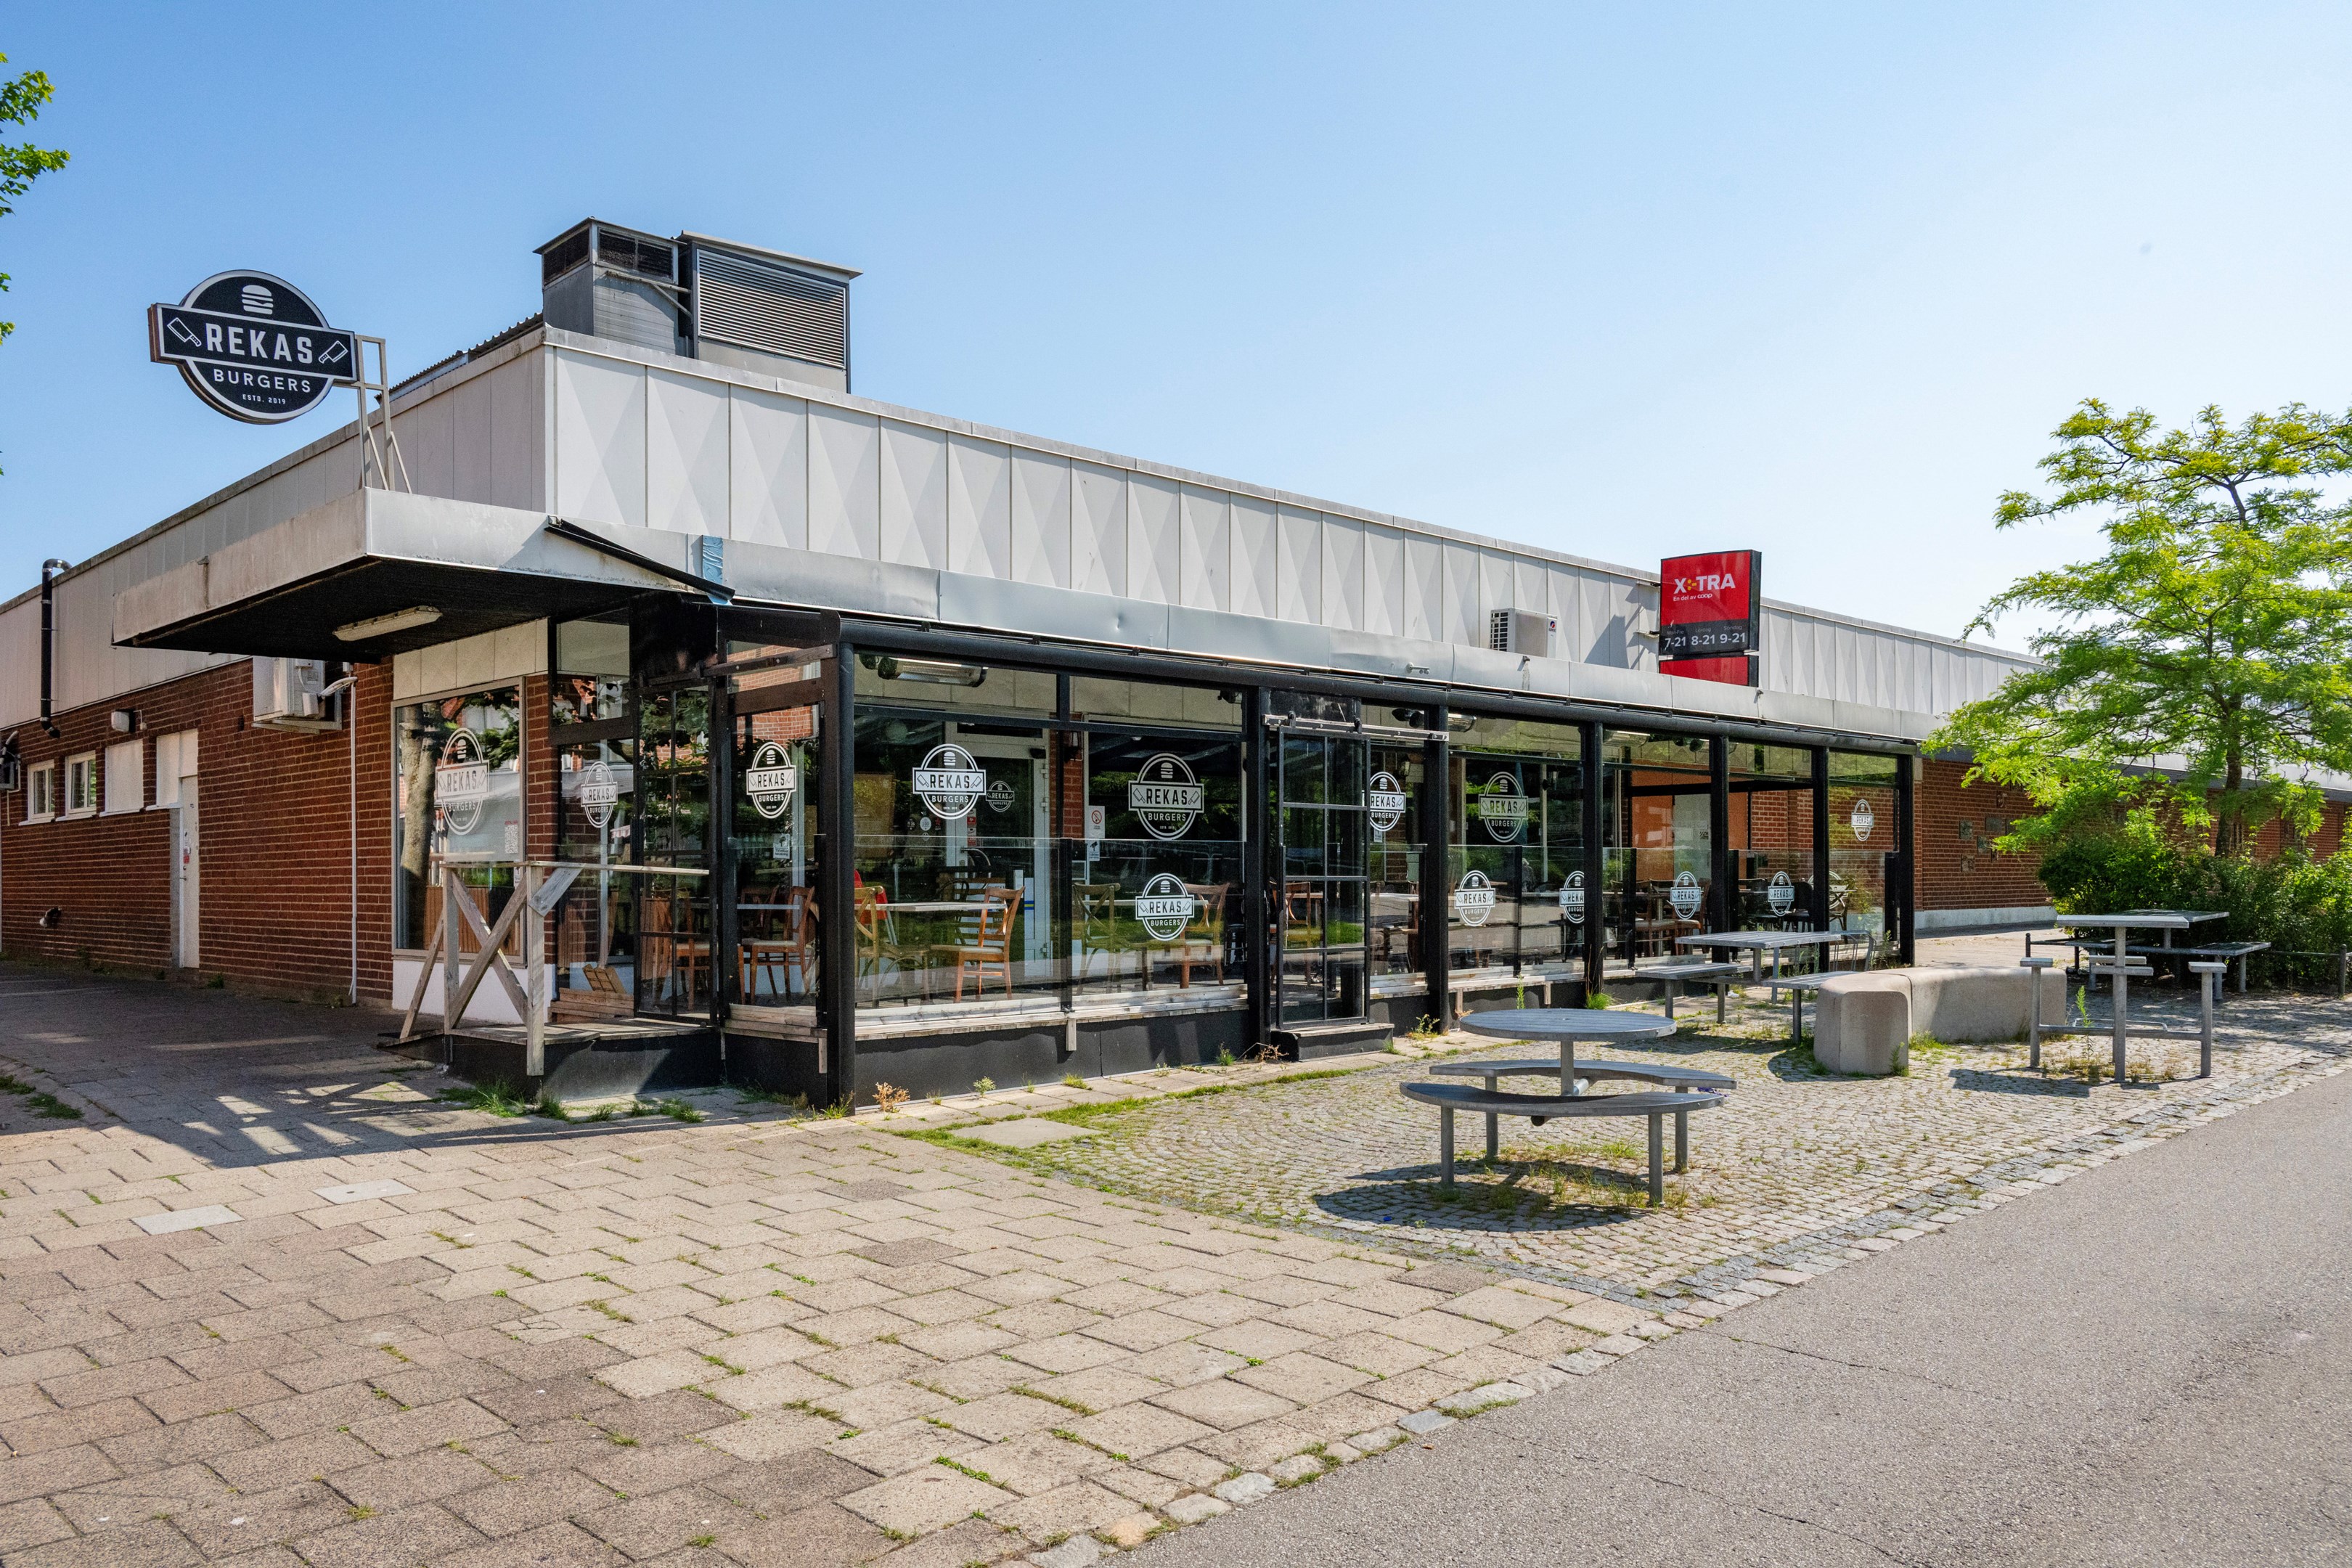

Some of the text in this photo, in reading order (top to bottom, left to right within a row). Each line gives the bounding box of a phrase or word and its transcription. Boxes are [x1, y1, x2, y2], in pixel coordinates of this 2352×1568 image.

[205, 323, 313, 364] REKAS
[213, 369, 311, 393] BURGERS
[242, 393, 264, 402] ESTD.
[1665, 632, 1745, 648] 7-21 8-21 9-21
[447, 770, 477, 793] REKAS
[758, 772, 785, 788] REKAS
[930, 774, 970, 789] REKAS
[589, 788, 610, 801] REKAS
[1146, 788, 1188, 805] REKAS
[449, 801, 476, 812] BURGERS
[1371, 796, 1395, 807] REKAS
[1490, 800, 1517, 814] REKAS
[1148, 812, 1186, 822] BURGERS
[1464, 894, 1487, 904] REKAS
[1568, 892, 1584, 902] REKA
[1678, 891, 1694, 900] REKAS
[1149, 901, 1182, 914] REKAS
